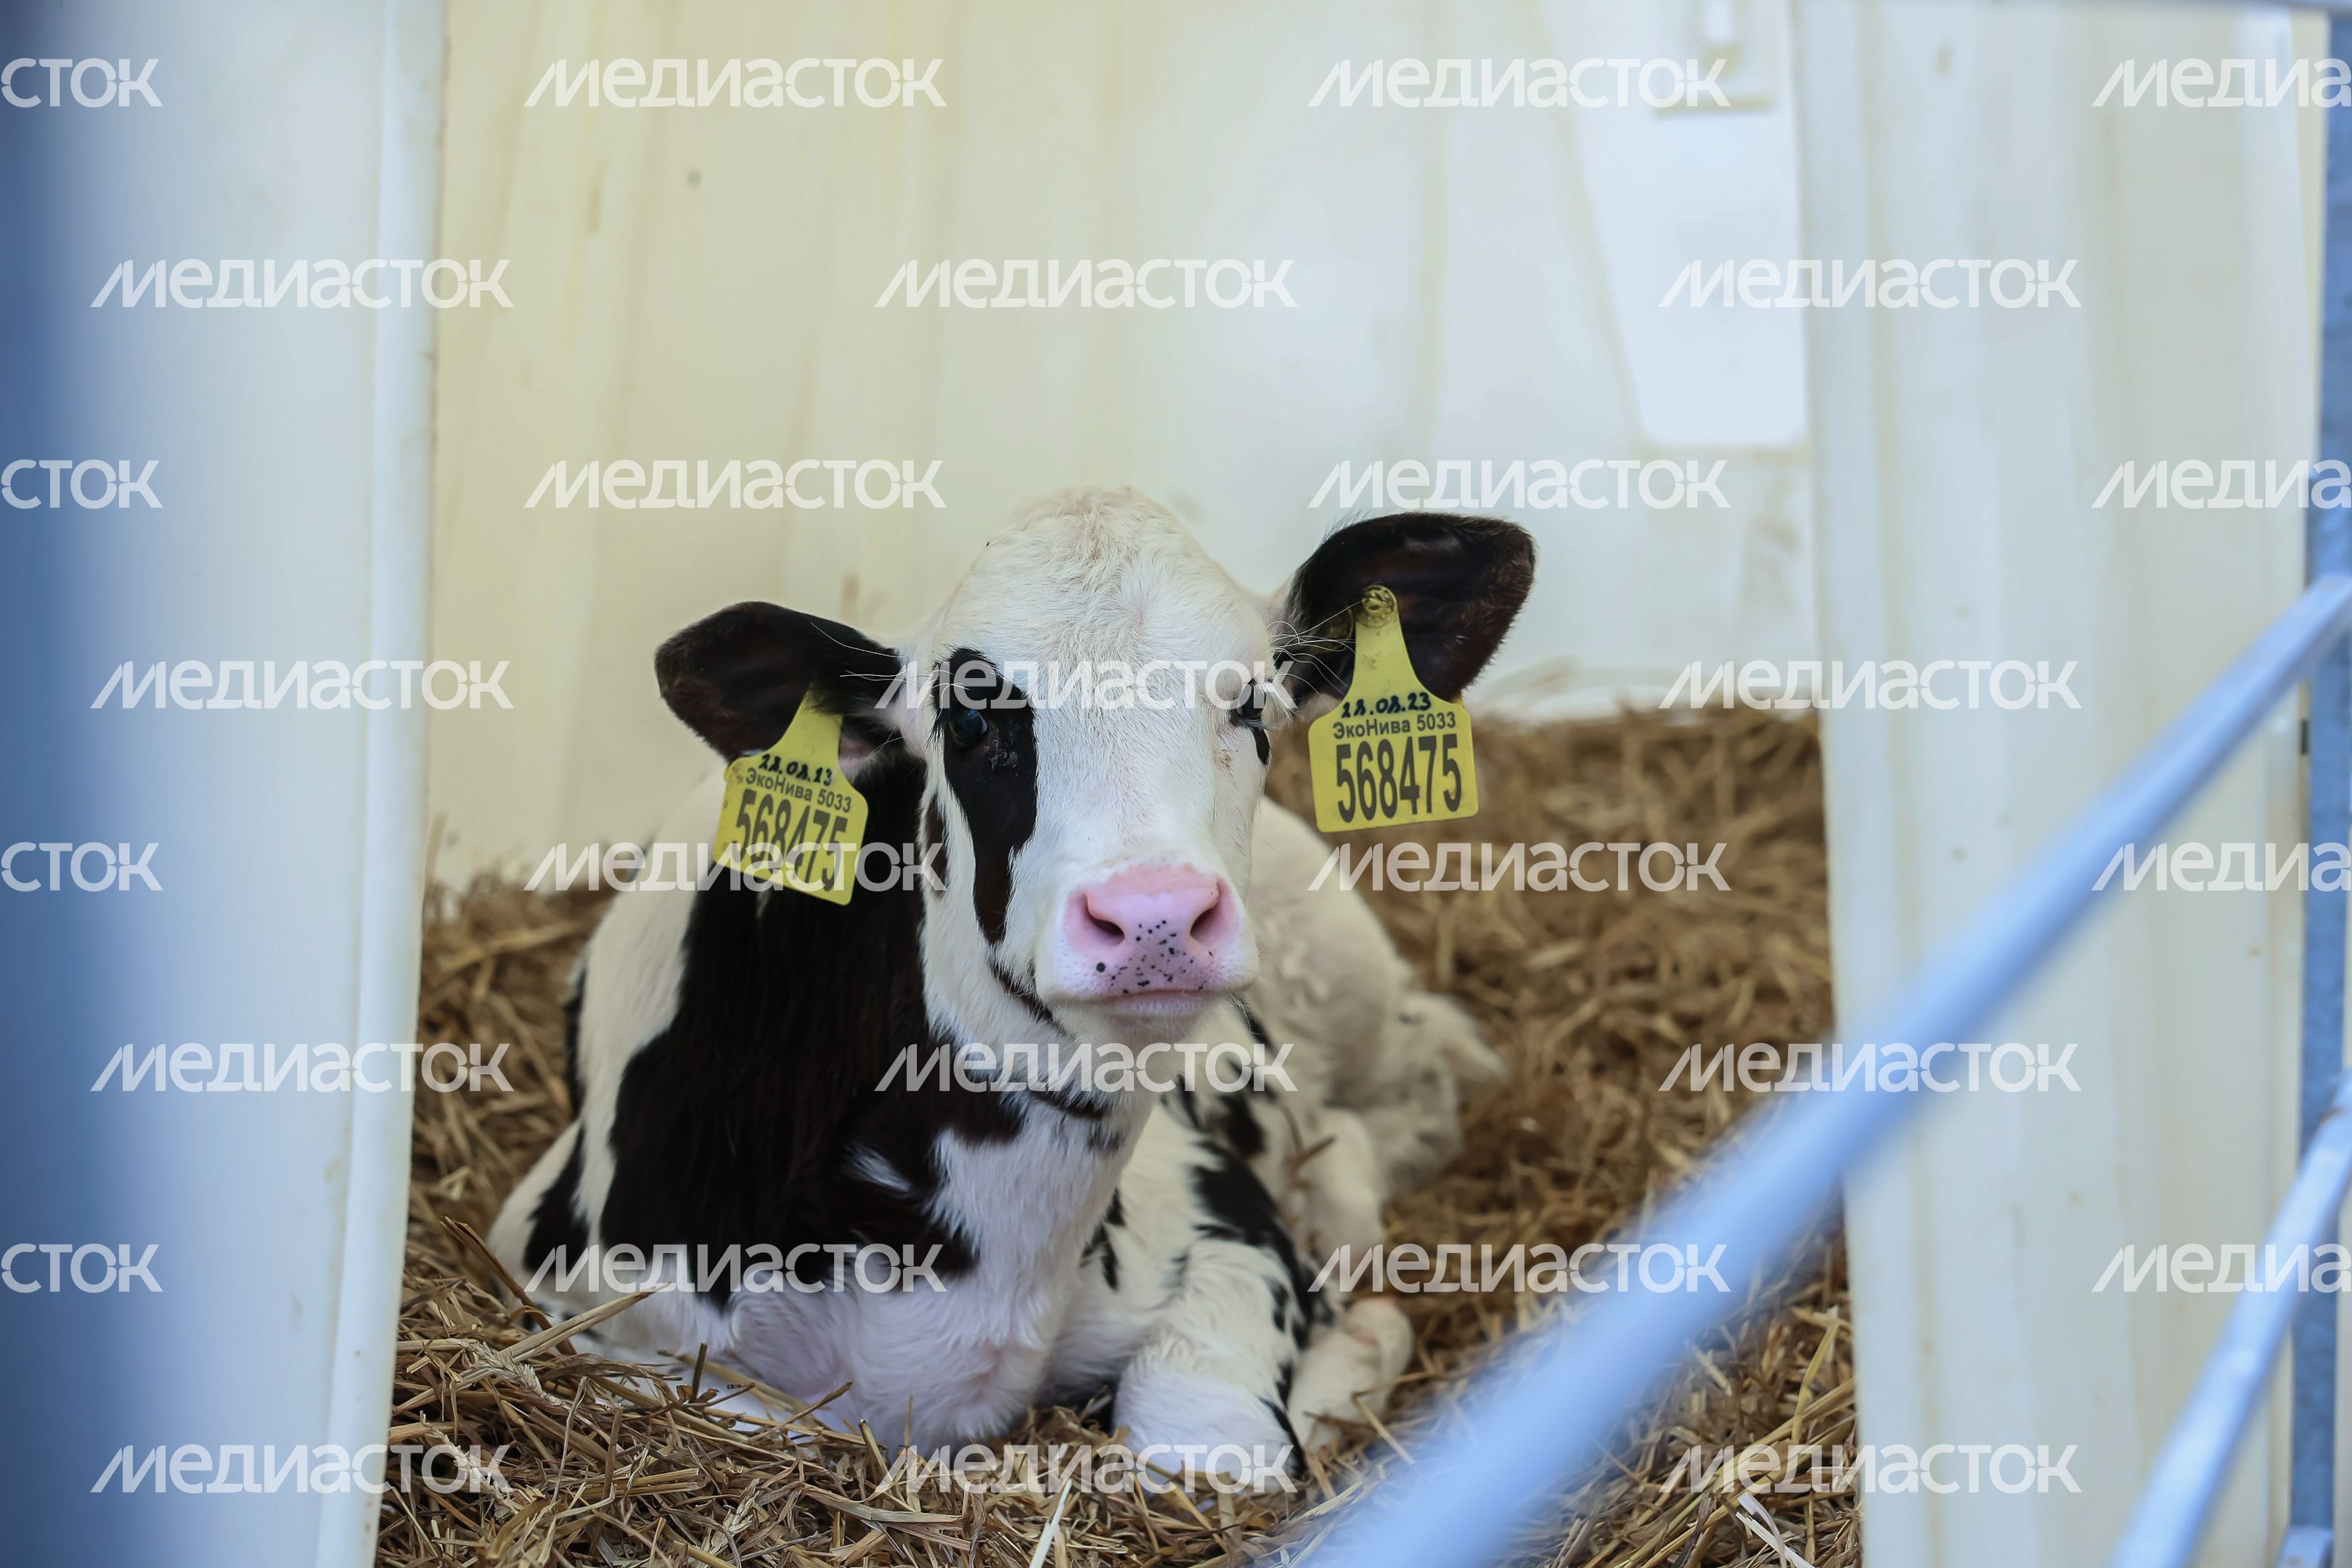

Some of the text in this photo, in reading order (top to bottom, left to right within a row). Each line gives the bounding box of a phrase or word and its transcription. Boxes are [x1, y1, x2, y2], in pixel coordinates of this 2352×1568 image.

[1333, 711, 1456, 740] ЭкоНива 5033
[746, 767, 852, 814] ЭкоНива 5033
[1336, 733, 1462, 823] 568475
[731, 788, 849, 892] 568475
